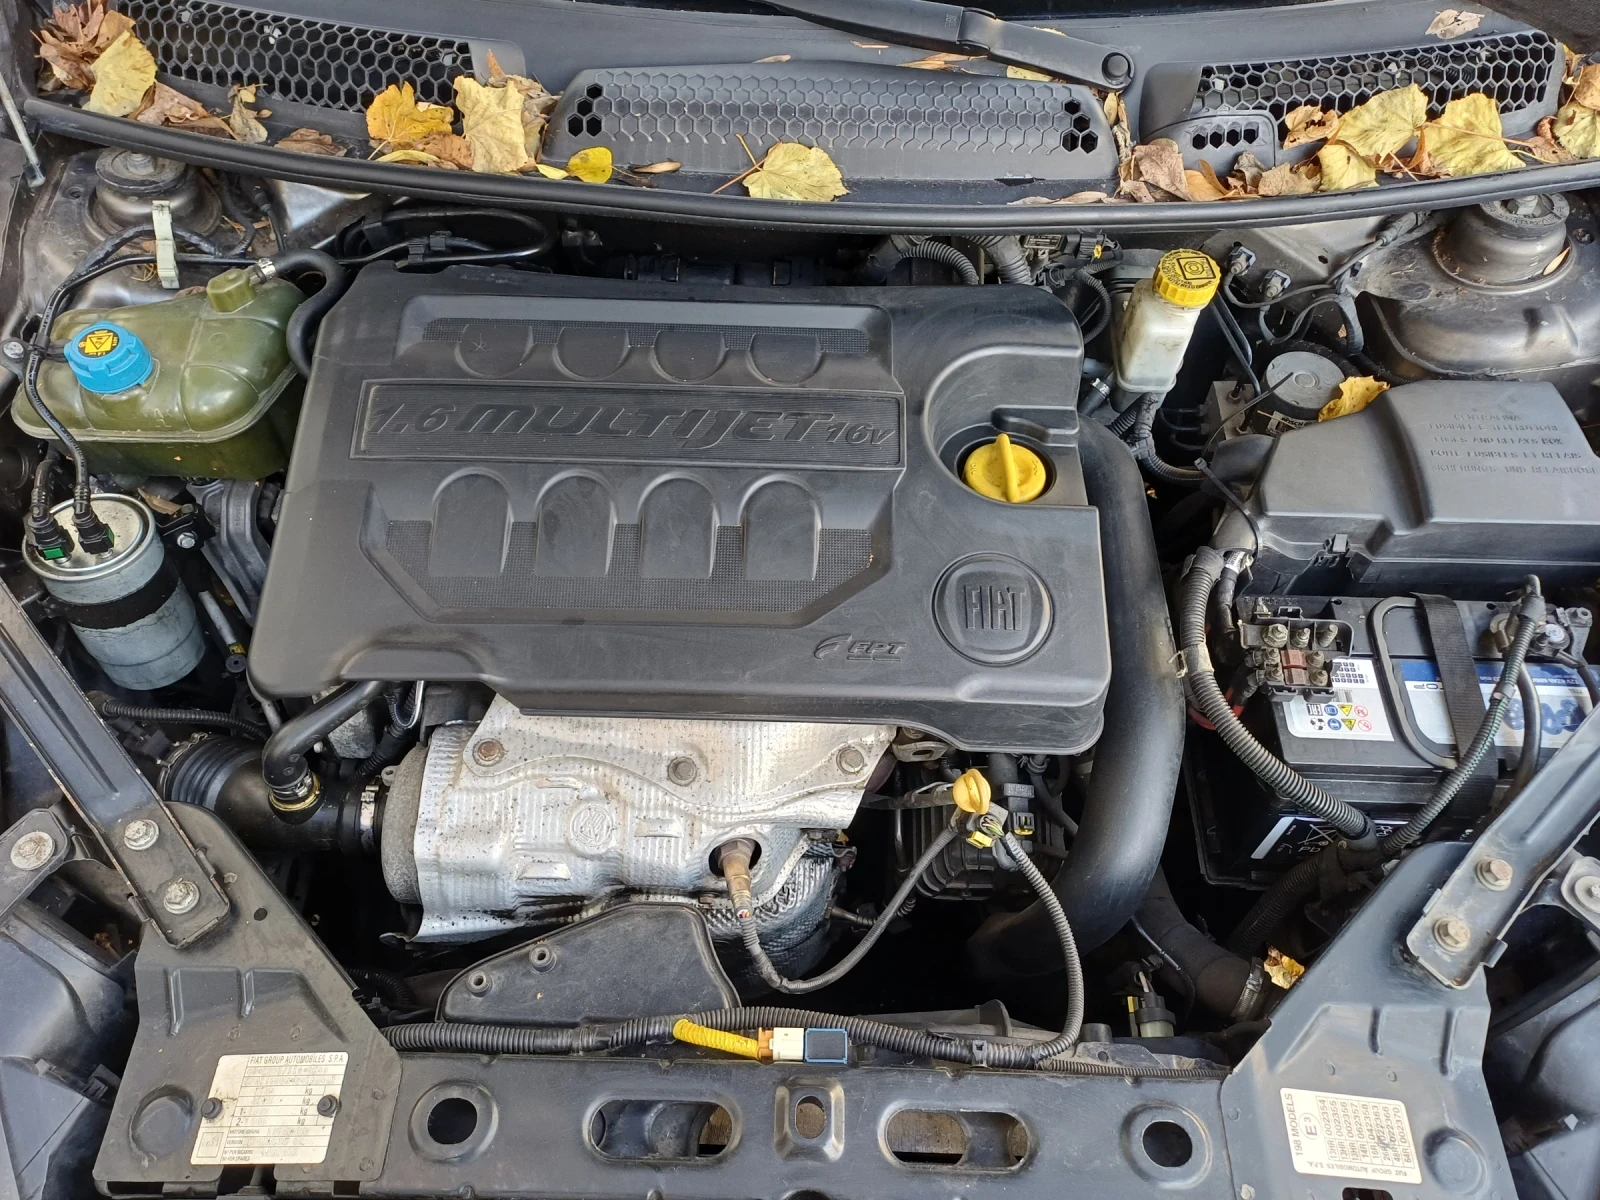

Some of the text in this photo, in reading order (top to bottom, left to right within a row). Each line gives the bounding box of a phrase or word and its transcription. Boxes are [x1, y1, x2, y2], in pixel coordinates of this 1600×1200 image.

[367, 403, 456, 434] 1.6
[453, 404, 835, 451] MULTIJET
[1541, 437, 1564, 445] BOX
[964, 585, 1027, 631] FIAT
[849, 641, 908, 656] FPT
[249, 1056, 263, 1065] FIAT
[264, 1056, 284, 1064] GROUP
[285, 1055, 326, 1064] AUTOMOBILES
[304, 1087, 313, 1096] kg
[302, 1096, 311, 1105] kg
[299, 1107, 308, 1116] kg
[1319, 1099, 1333, 1136] 002354
[1329, 1100, 1343, 1137] 002355
[1339, 1101, 1354, 1138] 002356
[296, 1117, 306, 1126] kg
[1284, 1093, 1304, 1157] 198 MODELS
[1303, 1116, 1318, 1136] E 3
[1350, 1102, 1369, 1158] 14R 062357
[1392, 1107, 1407, 1144] 002370
[1326, 1163, 1369, 1174] AUTOMOBILES
[1371, 1167, 1393, 1175] GROUP
